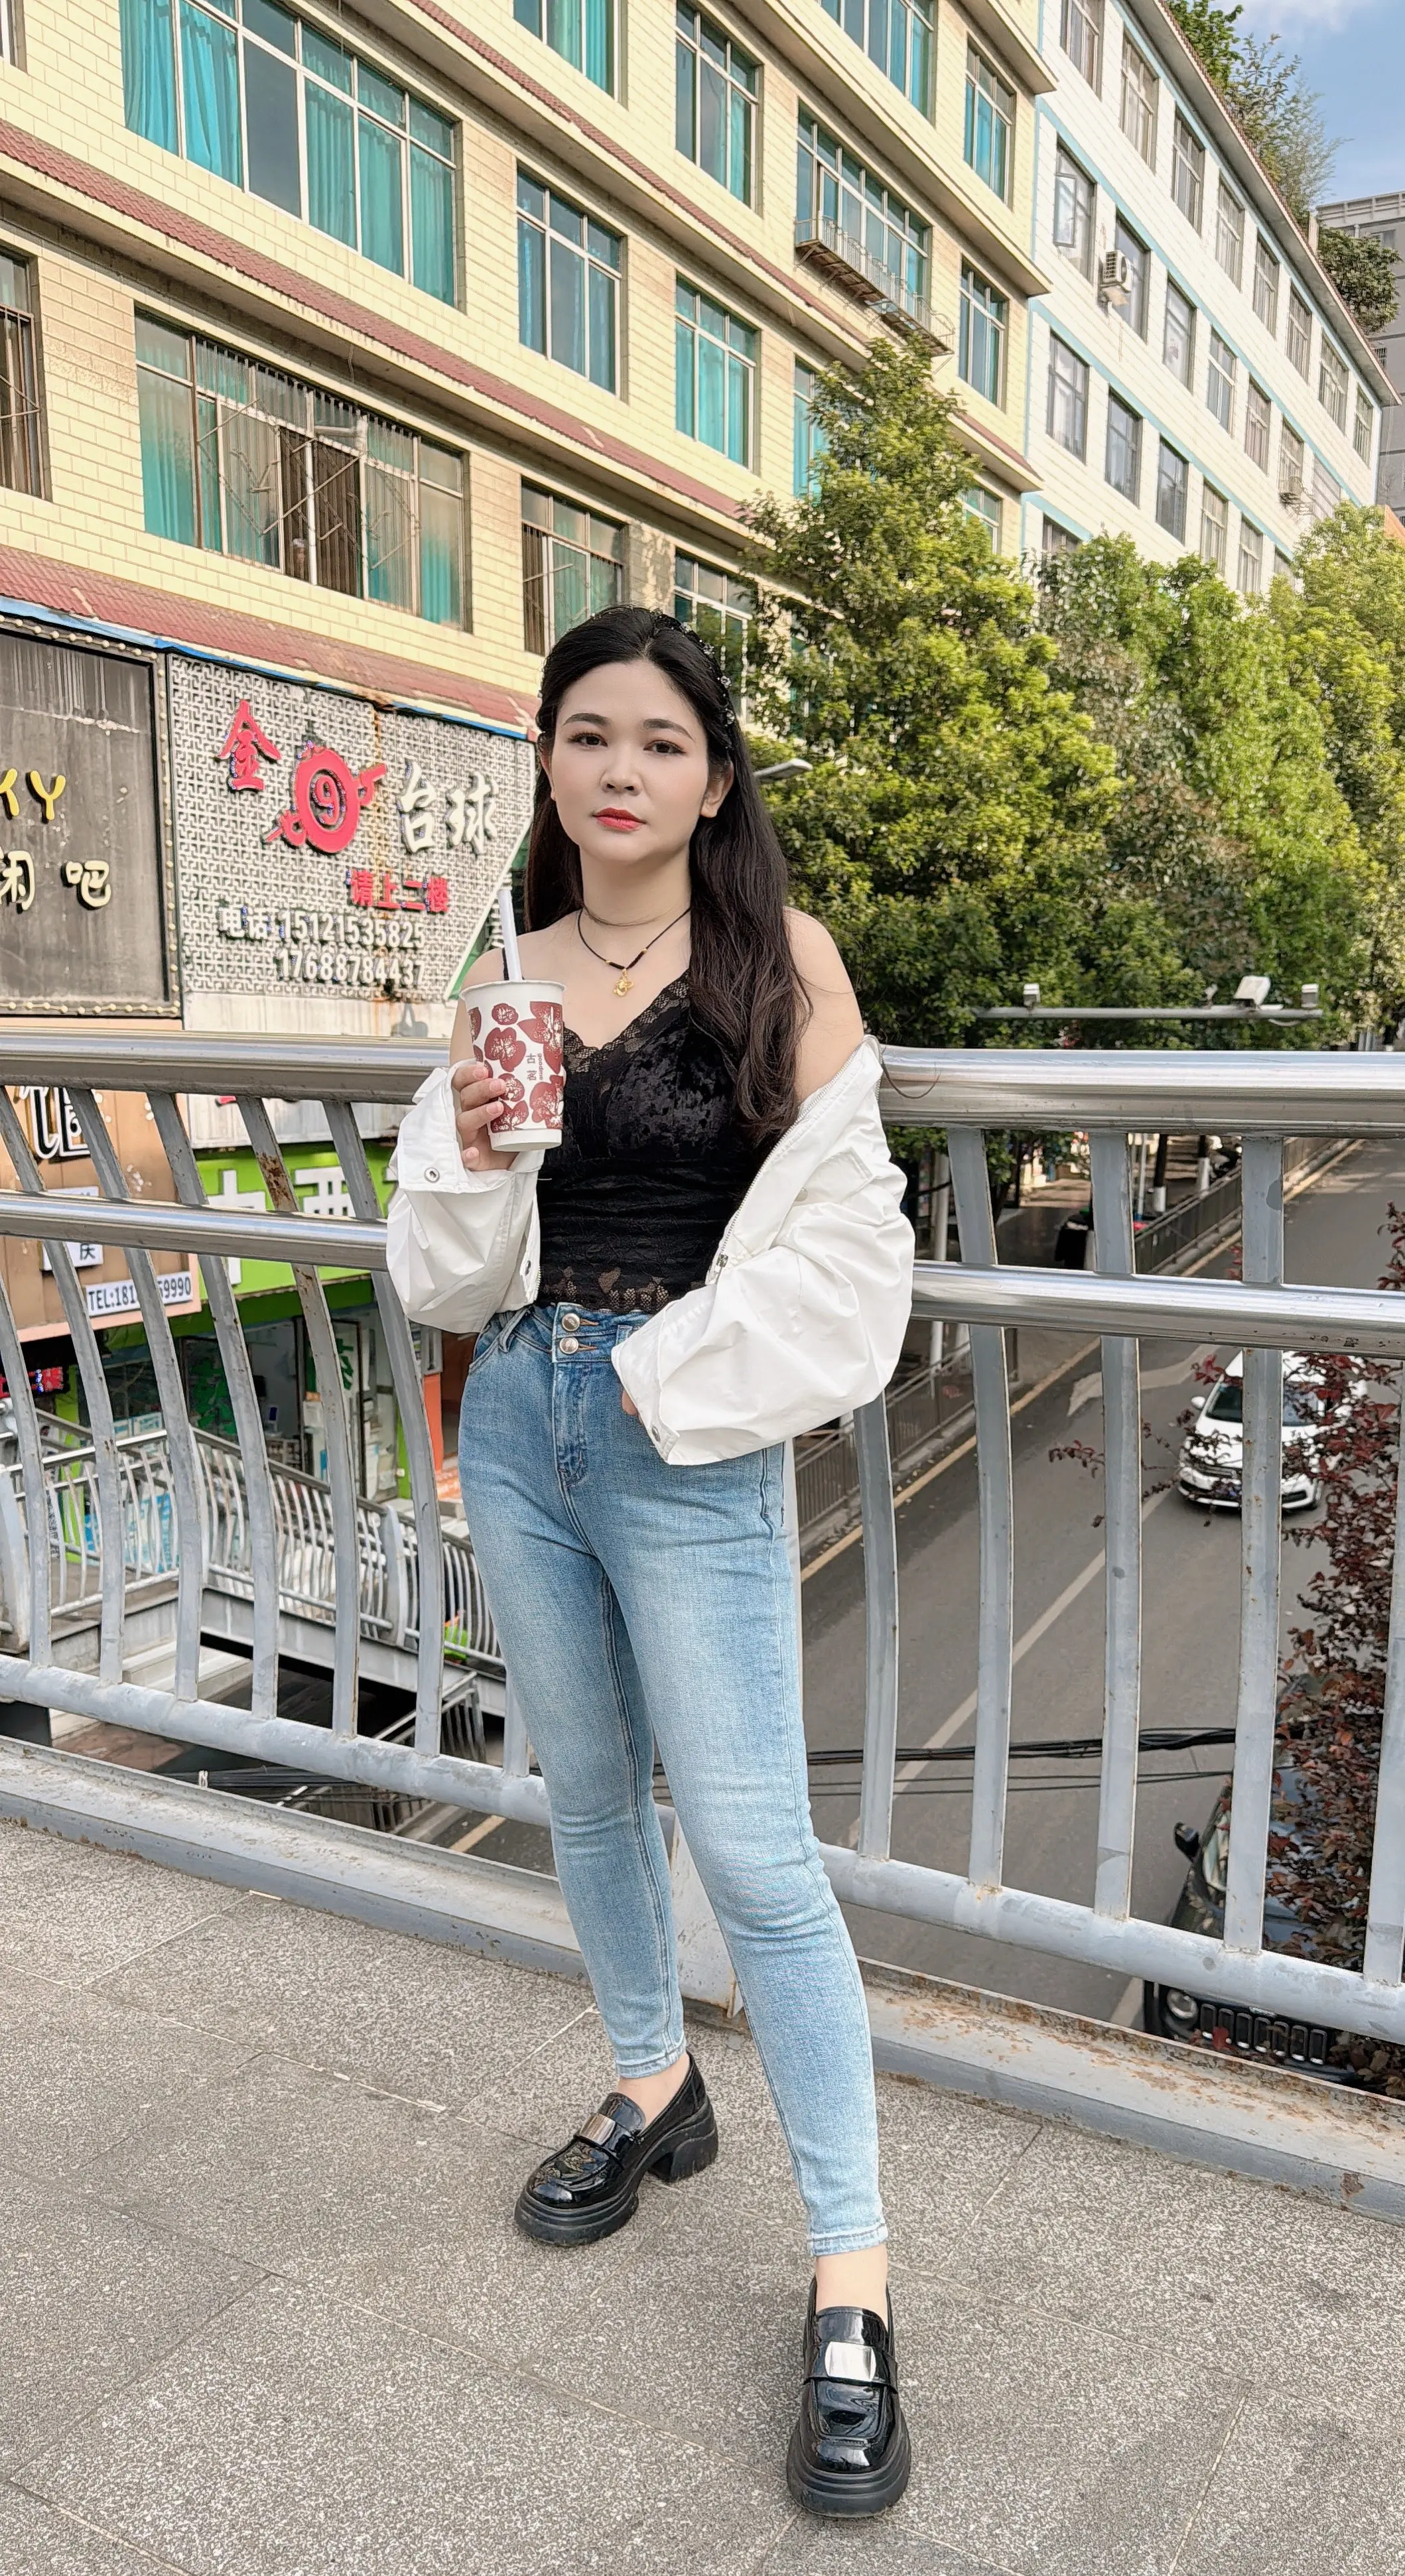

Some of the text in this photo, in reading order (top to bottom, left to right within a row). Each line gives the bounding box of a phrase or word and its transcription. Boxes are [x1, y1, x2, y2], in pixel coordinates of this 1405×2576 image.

[350, 868, 448, 913] 请上二楼
[277, 949, 425, 986] 17688784437
